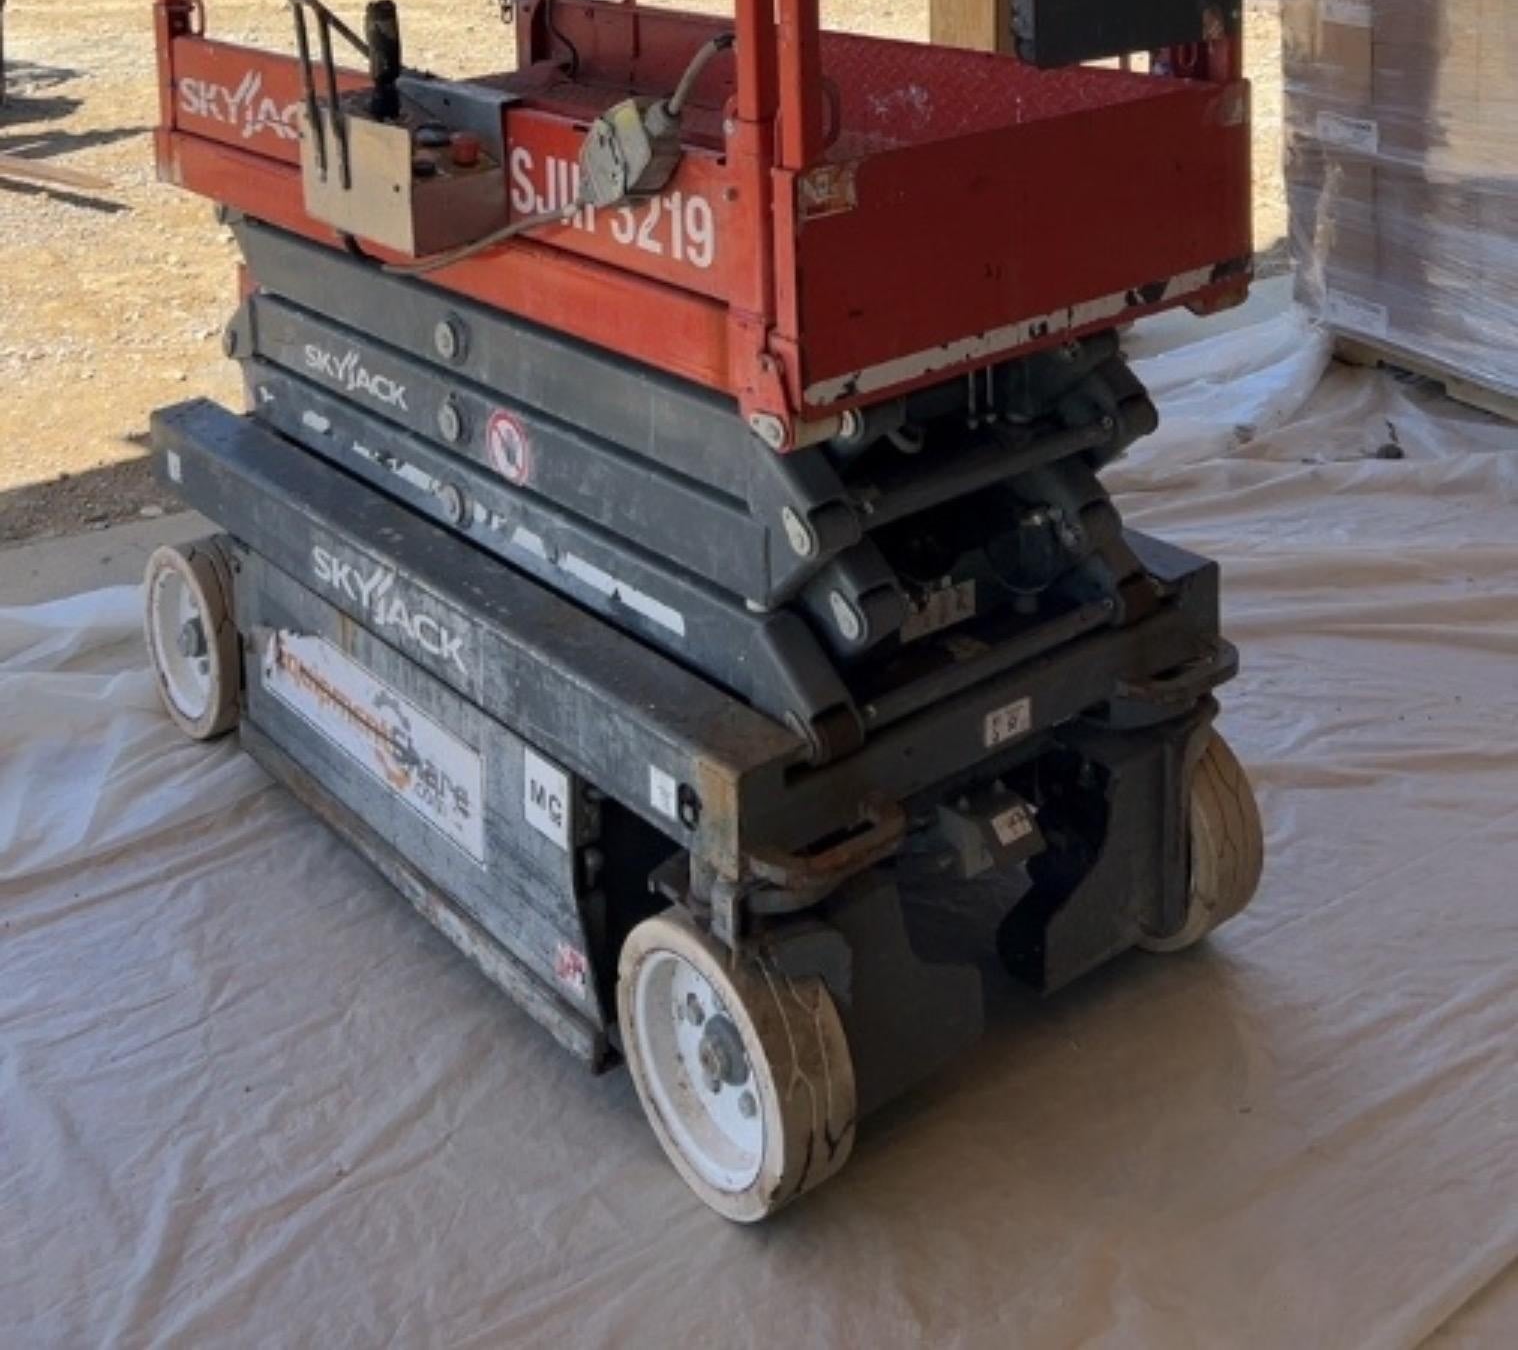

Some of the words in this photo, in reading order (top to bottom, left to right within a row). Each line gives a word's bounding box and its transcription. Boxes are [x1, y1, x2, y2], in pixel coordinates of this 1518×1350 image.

[179, 68, 301, 139] SKYJAC
[609, 190, 715, 268] 3219
[303, 343, 408, 412] SKYJACK
[311, 544, 467, 674] SKYJACK
